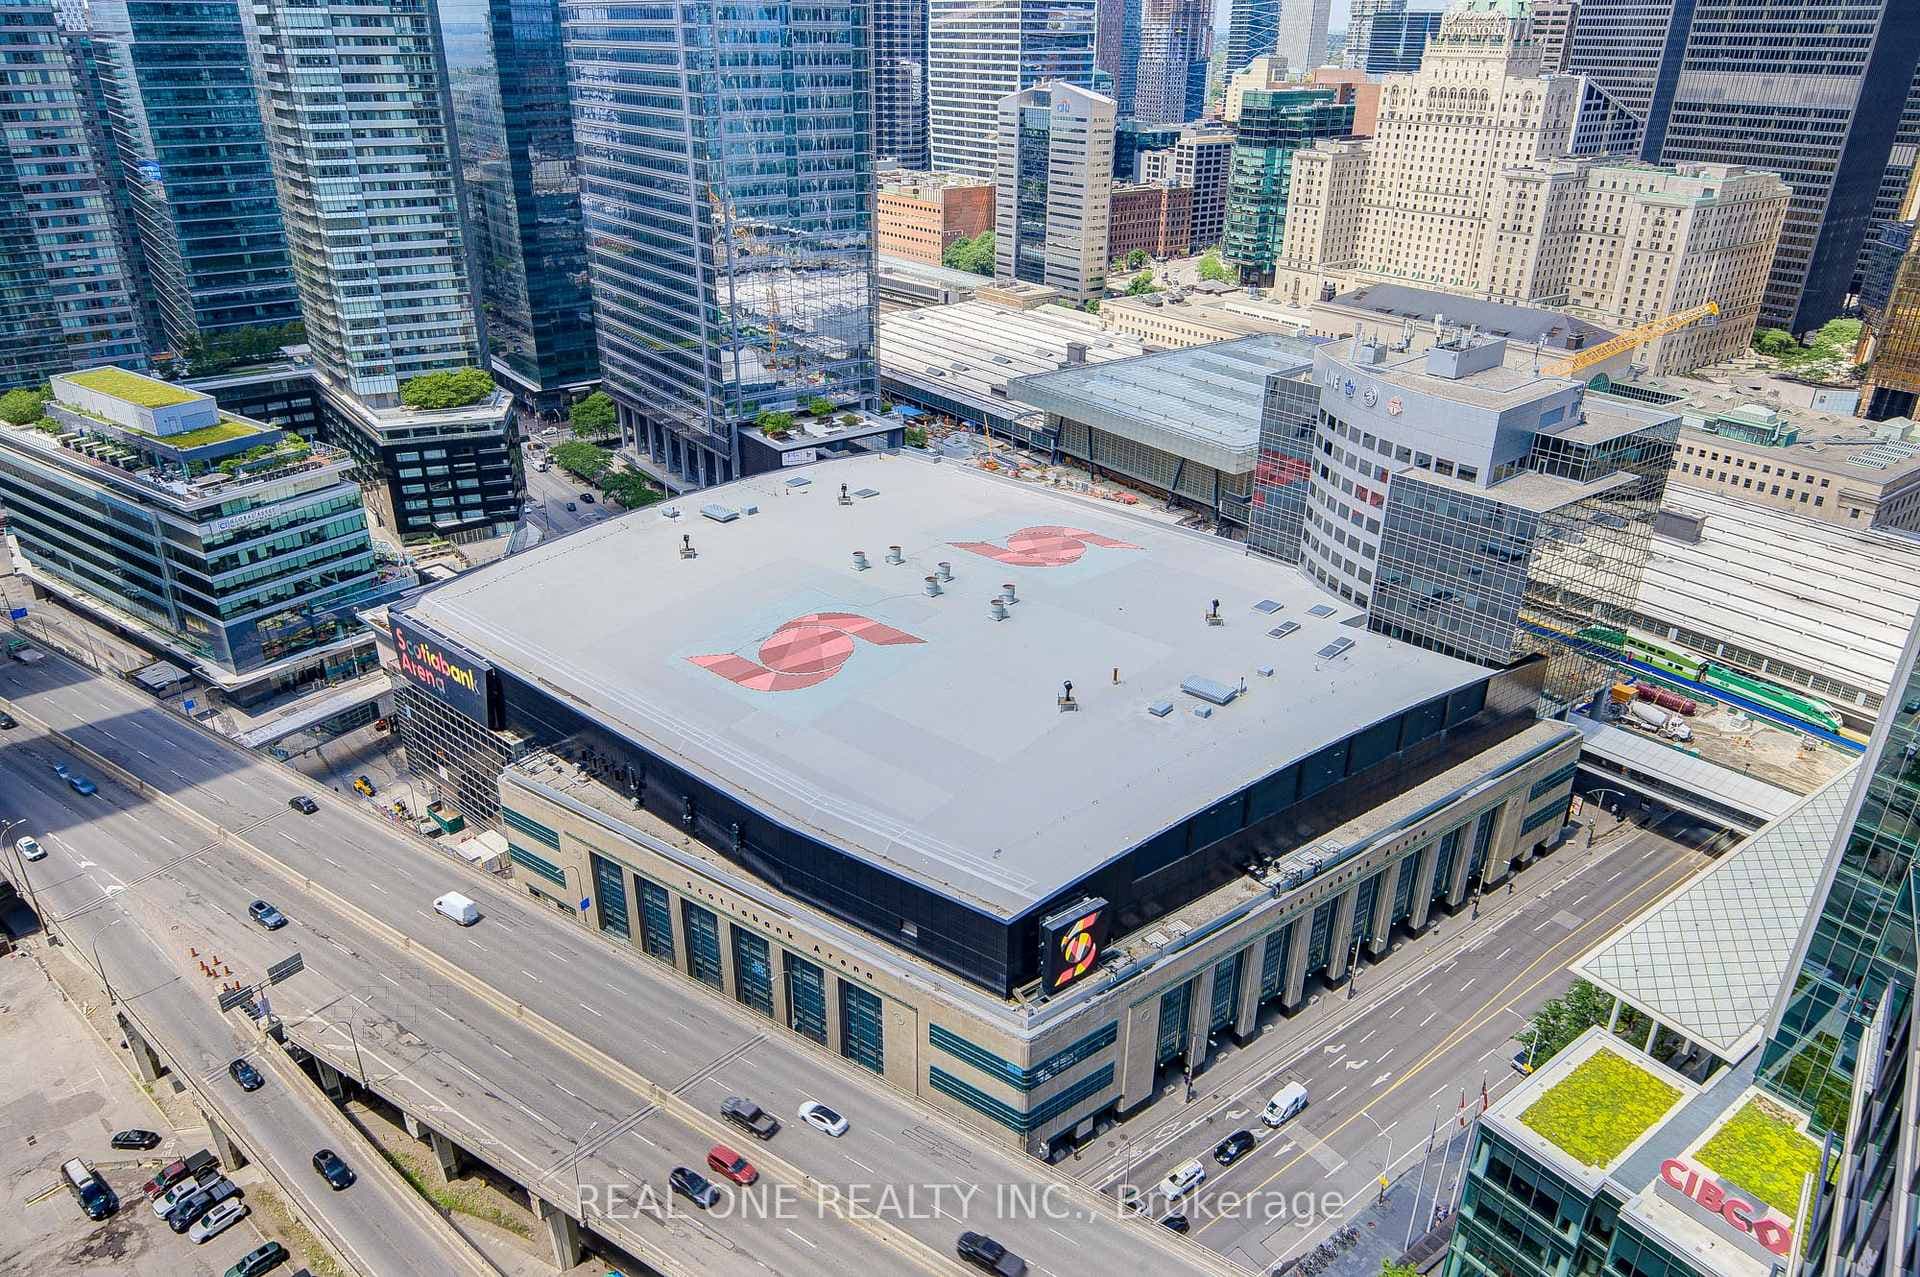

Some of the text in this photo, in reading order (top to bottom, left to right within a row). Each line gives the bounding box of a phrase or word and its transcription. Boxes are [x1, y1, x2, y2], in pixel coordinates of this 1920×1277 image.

[396, 627, 480, 696] Scotiabank
[401, 652, 446, 694] Arena
[687, 881, 873, 980] Scotiabank Arena
[1660, 1158, 1754, 1232] CIBC
